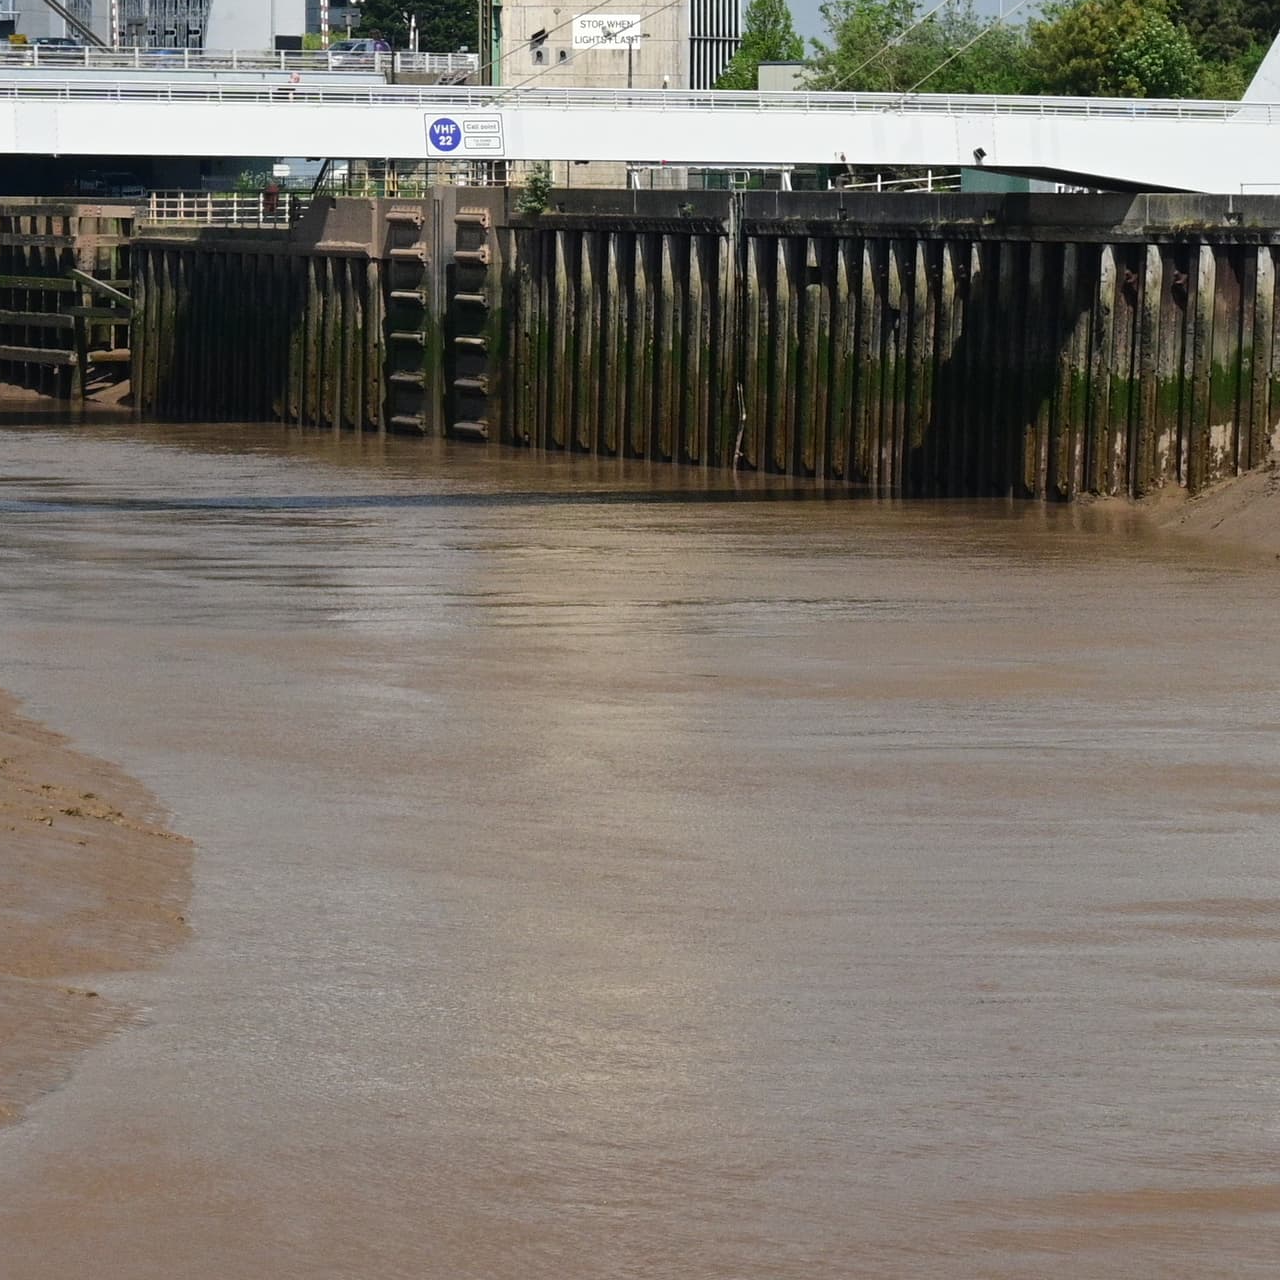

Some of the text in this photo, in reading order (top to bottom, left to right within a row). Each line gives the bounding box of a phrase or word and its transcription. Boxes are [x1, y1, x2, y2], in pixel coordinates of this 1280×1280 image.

[580, 20, 634, 29] STOP WHEN
[575, 35, 607, 44] LIGHTS
[433, 124, 456, 134] VHF
[439, 135, 453, 146] 22
